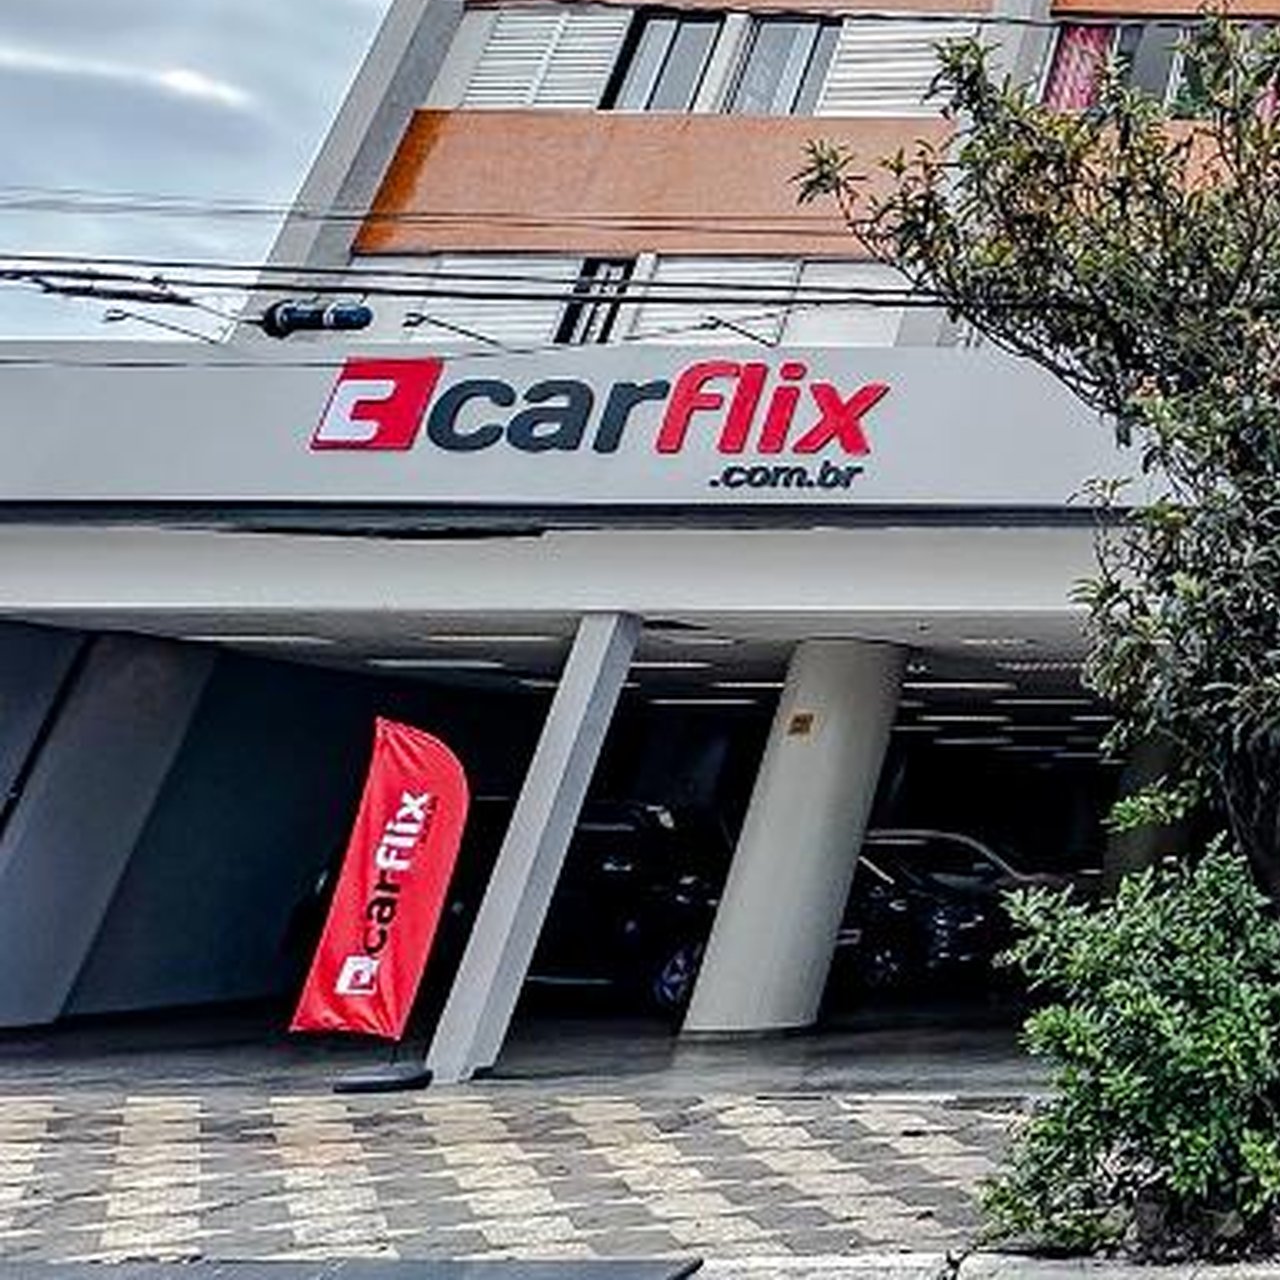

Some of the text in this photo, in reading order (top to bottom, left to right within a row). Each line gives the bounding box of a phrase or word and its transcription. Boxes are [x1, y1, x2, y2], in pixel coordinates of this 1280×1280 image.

[426, 358, 890, 454] carflix
[709, 460, 864, 489] .com.br
[363, 789, 431, 957] carflix
